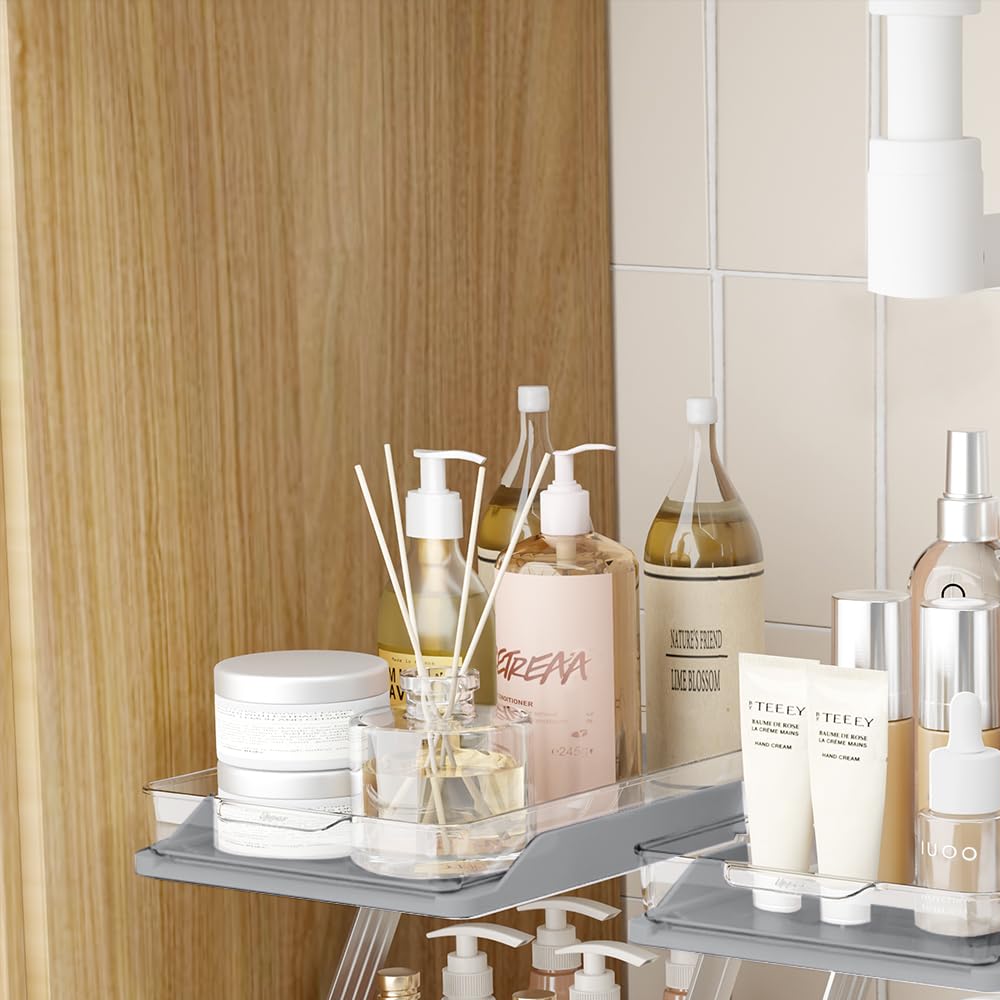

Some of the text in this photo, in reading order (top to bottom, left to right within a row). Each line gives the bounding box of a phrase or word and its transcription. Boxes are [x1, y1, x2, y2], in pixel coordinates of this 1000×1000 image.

[699, 629, 723, 649] FRIEND
[671, 669, 721, 692] LIME BLOSSOM
[755, 701, 806, 717] TEEEY
[752, 719, 800, 730] BAUME DE ROSE
[822, 712, 875, 728] TEEEY
[780, 729, 799, 737] MAINS
[818, 730, 840, 739] BAUME
[770, 742, 792, 750] CREAM
[847, 741, 868, 749] MAINS
[822, 752, 860, 762] HAND CREAM
